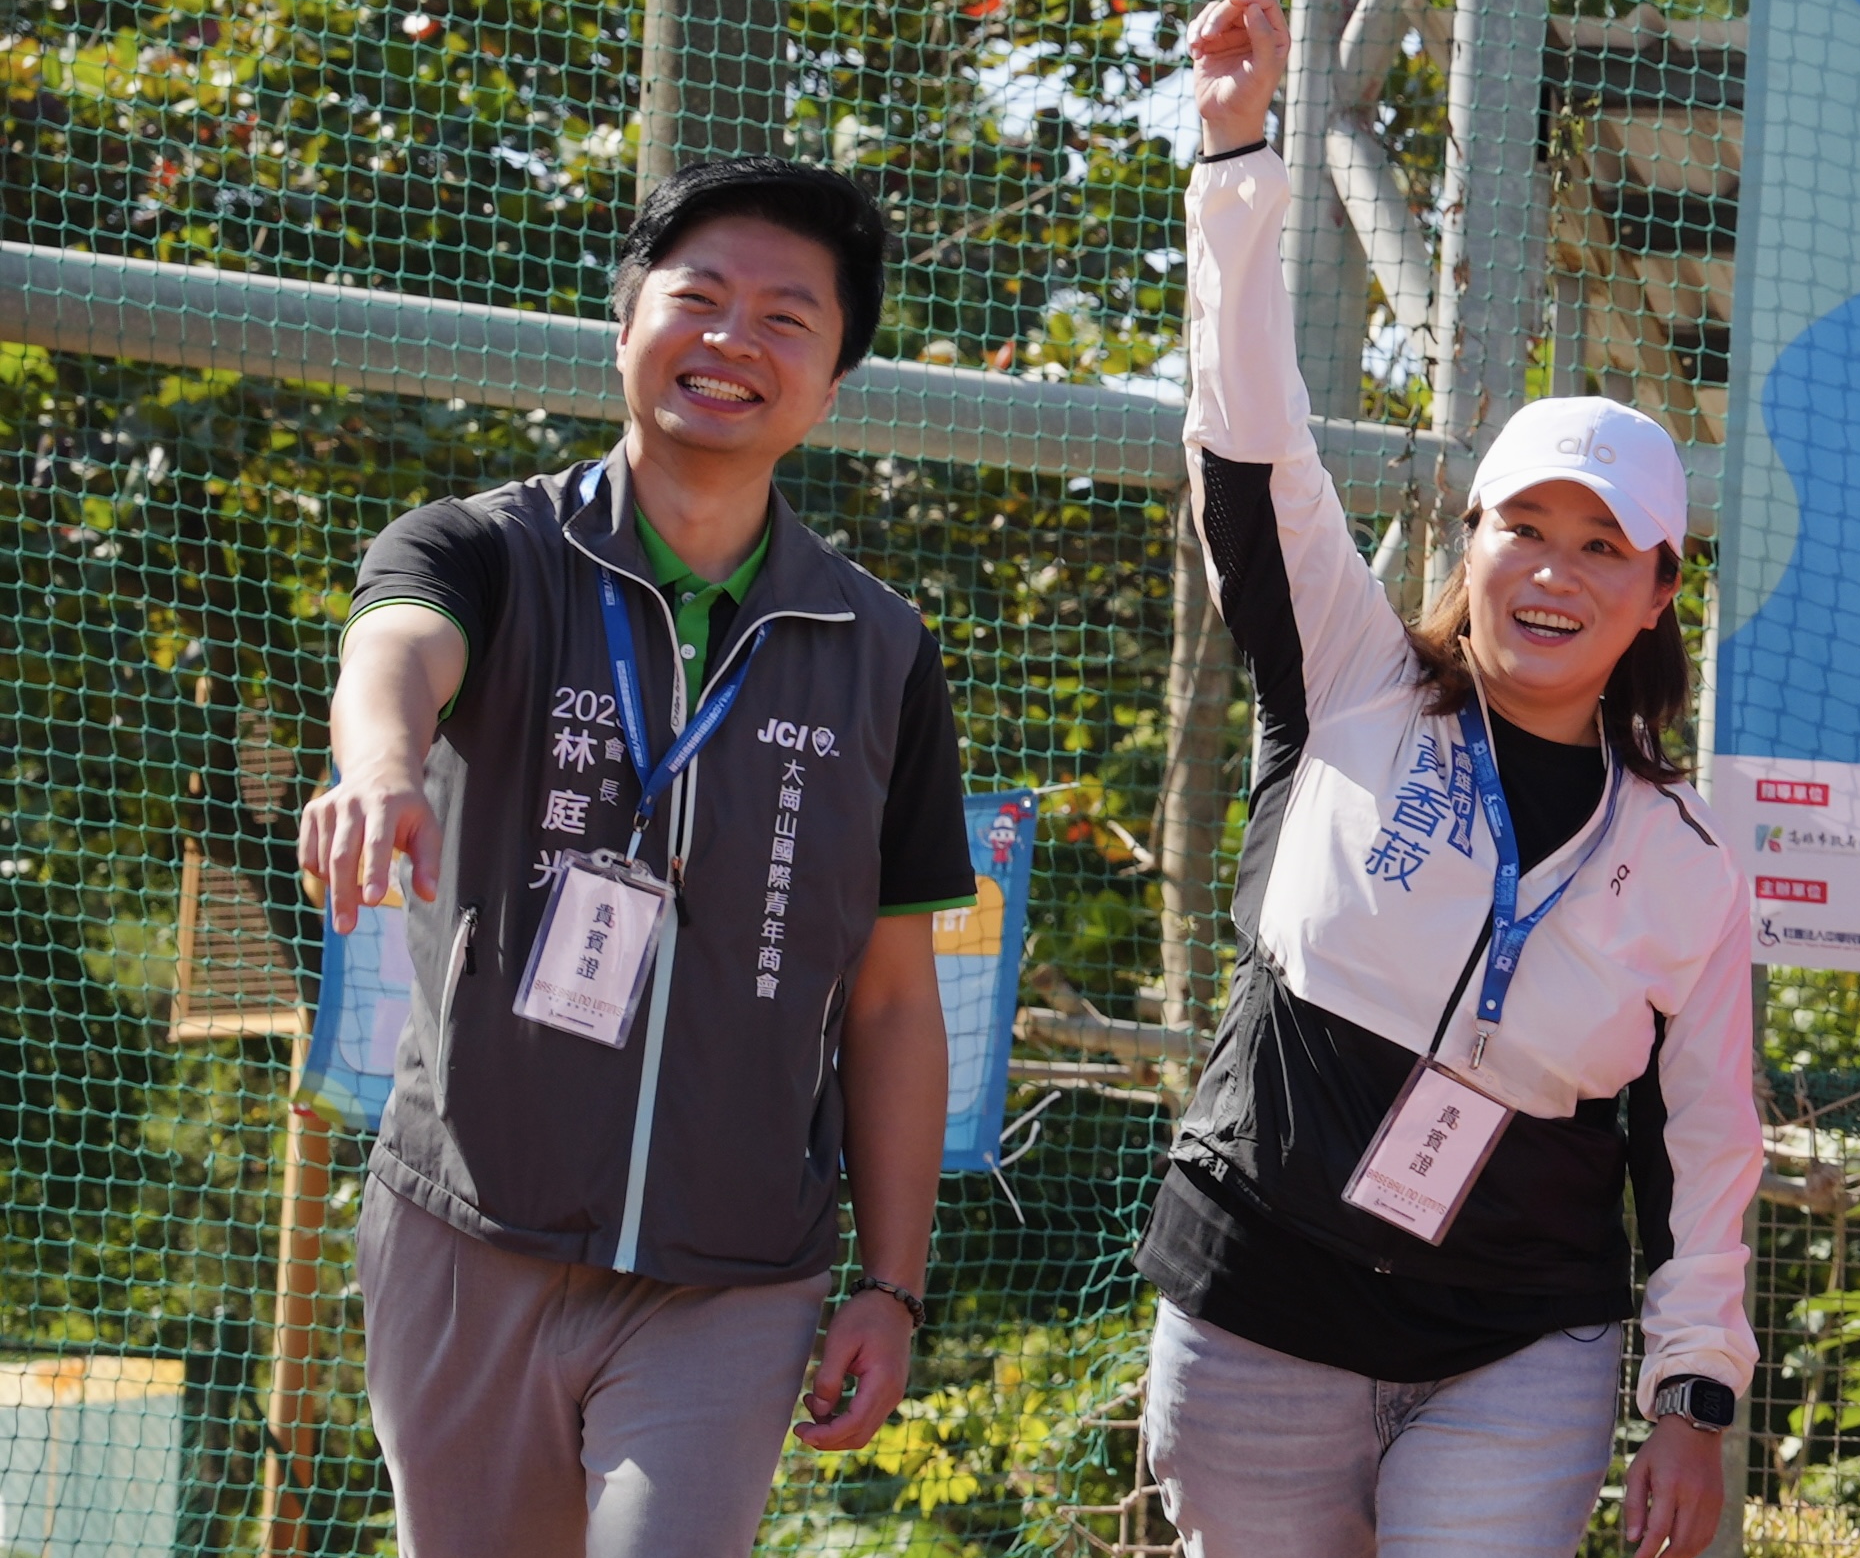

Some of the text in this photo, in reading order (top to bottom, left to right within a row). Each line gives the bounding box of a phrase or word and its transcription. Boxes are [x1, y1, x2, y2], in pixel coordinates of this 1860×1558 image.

[1556, 430, 1617, 464] alo
[551, 686, 624, 730] 202
[757, 718, 809, 752] JCI
[598, 737, 627, 808] 會長
[576, 902, 616, 981] 貴賓證
[1409, 1105, 1461, 1178] 貴賓證
